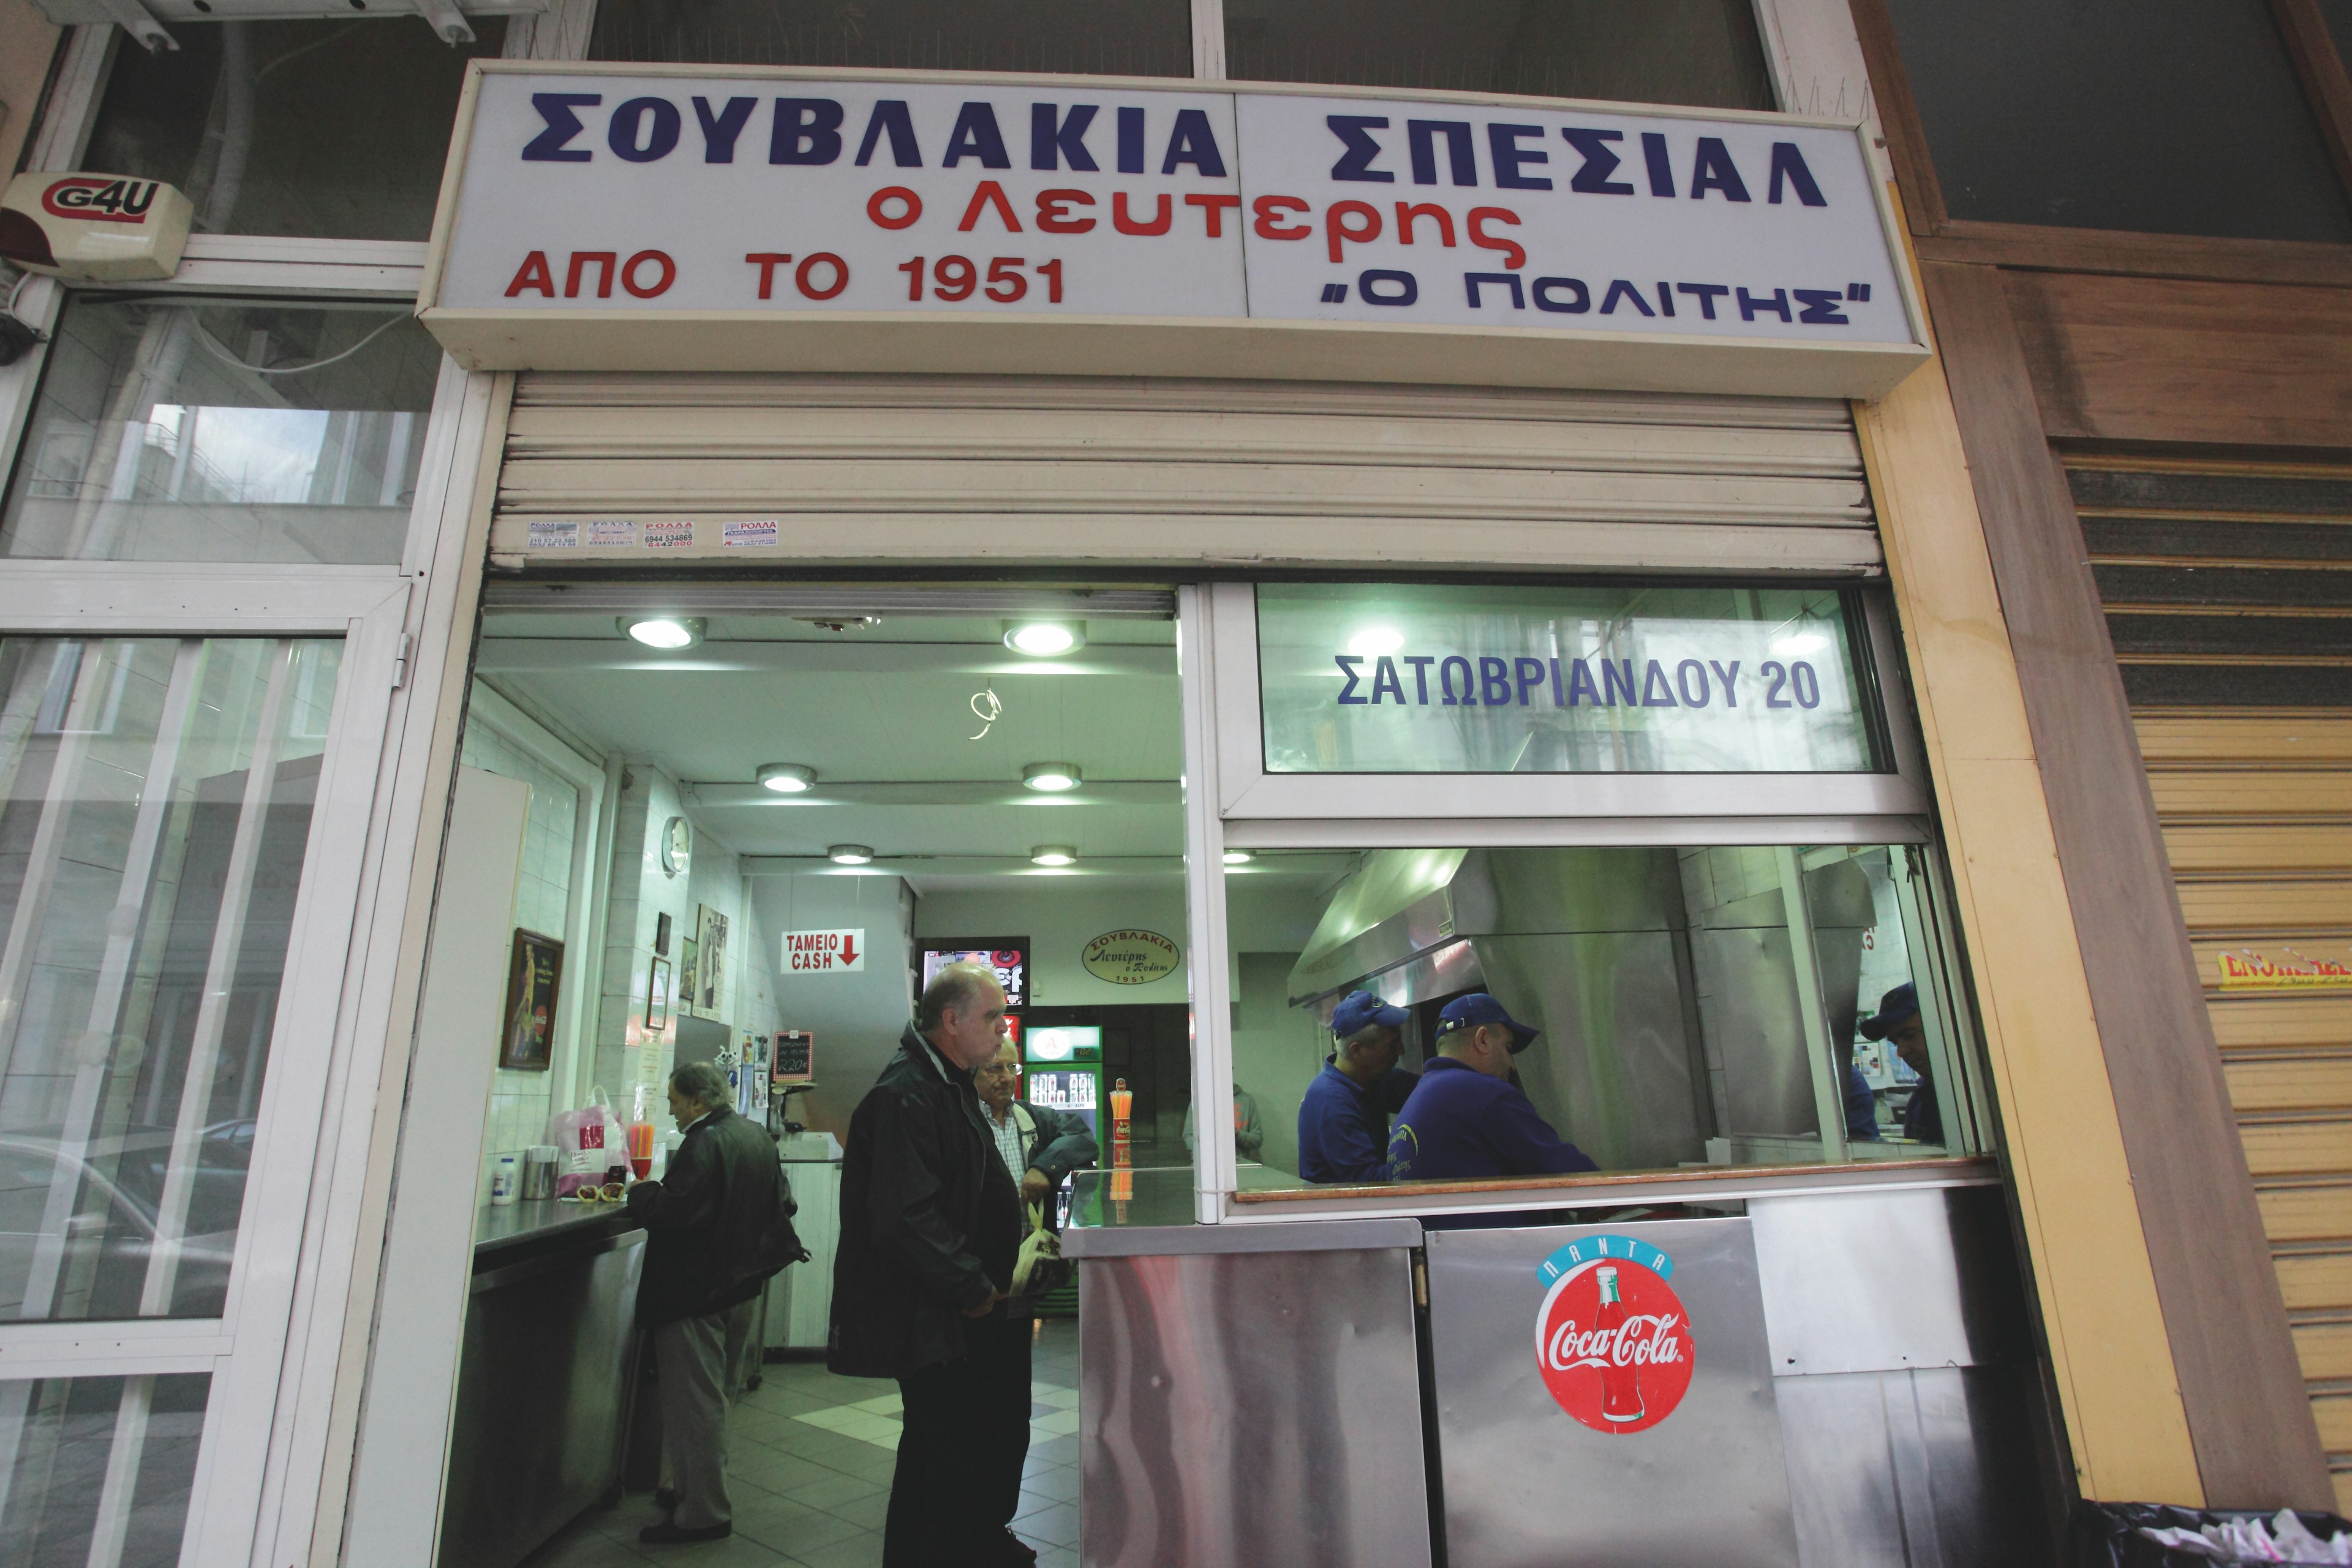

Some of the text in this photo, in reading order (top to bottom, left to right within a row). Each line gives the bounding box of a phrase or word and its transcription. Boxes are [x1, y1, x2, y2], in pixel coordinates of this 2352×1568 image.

[521, 92, 1828, 207] ΣΟΥΒΛΑΚΙΑ ΣΠΕΣΙΑΛ
[57, 180, 159, 215] G4U
[957, 180, 1526, 270] Λευτερης
[503, 249, 1062, 303] ΑΠΟ ΤΟ 1951
[1335, 655, 1820, 709] ΣΑΤΩΒΡΙΑΝΔΟΥ 20
[786, 933, 838, 951] ΤΑΜΕΙΟ
[791, 952, 832, 970] CASH
[1090, 949, 1147, 965] Λευτέρης
[1091, 932, 1172, 953] ΣΟΥΒΛΑΚΙΑ
[1543, 1237, 1665, 1278] ΠΑΝΤΑ
[1548, 1313, 1680, 1371] Coca-Cola
